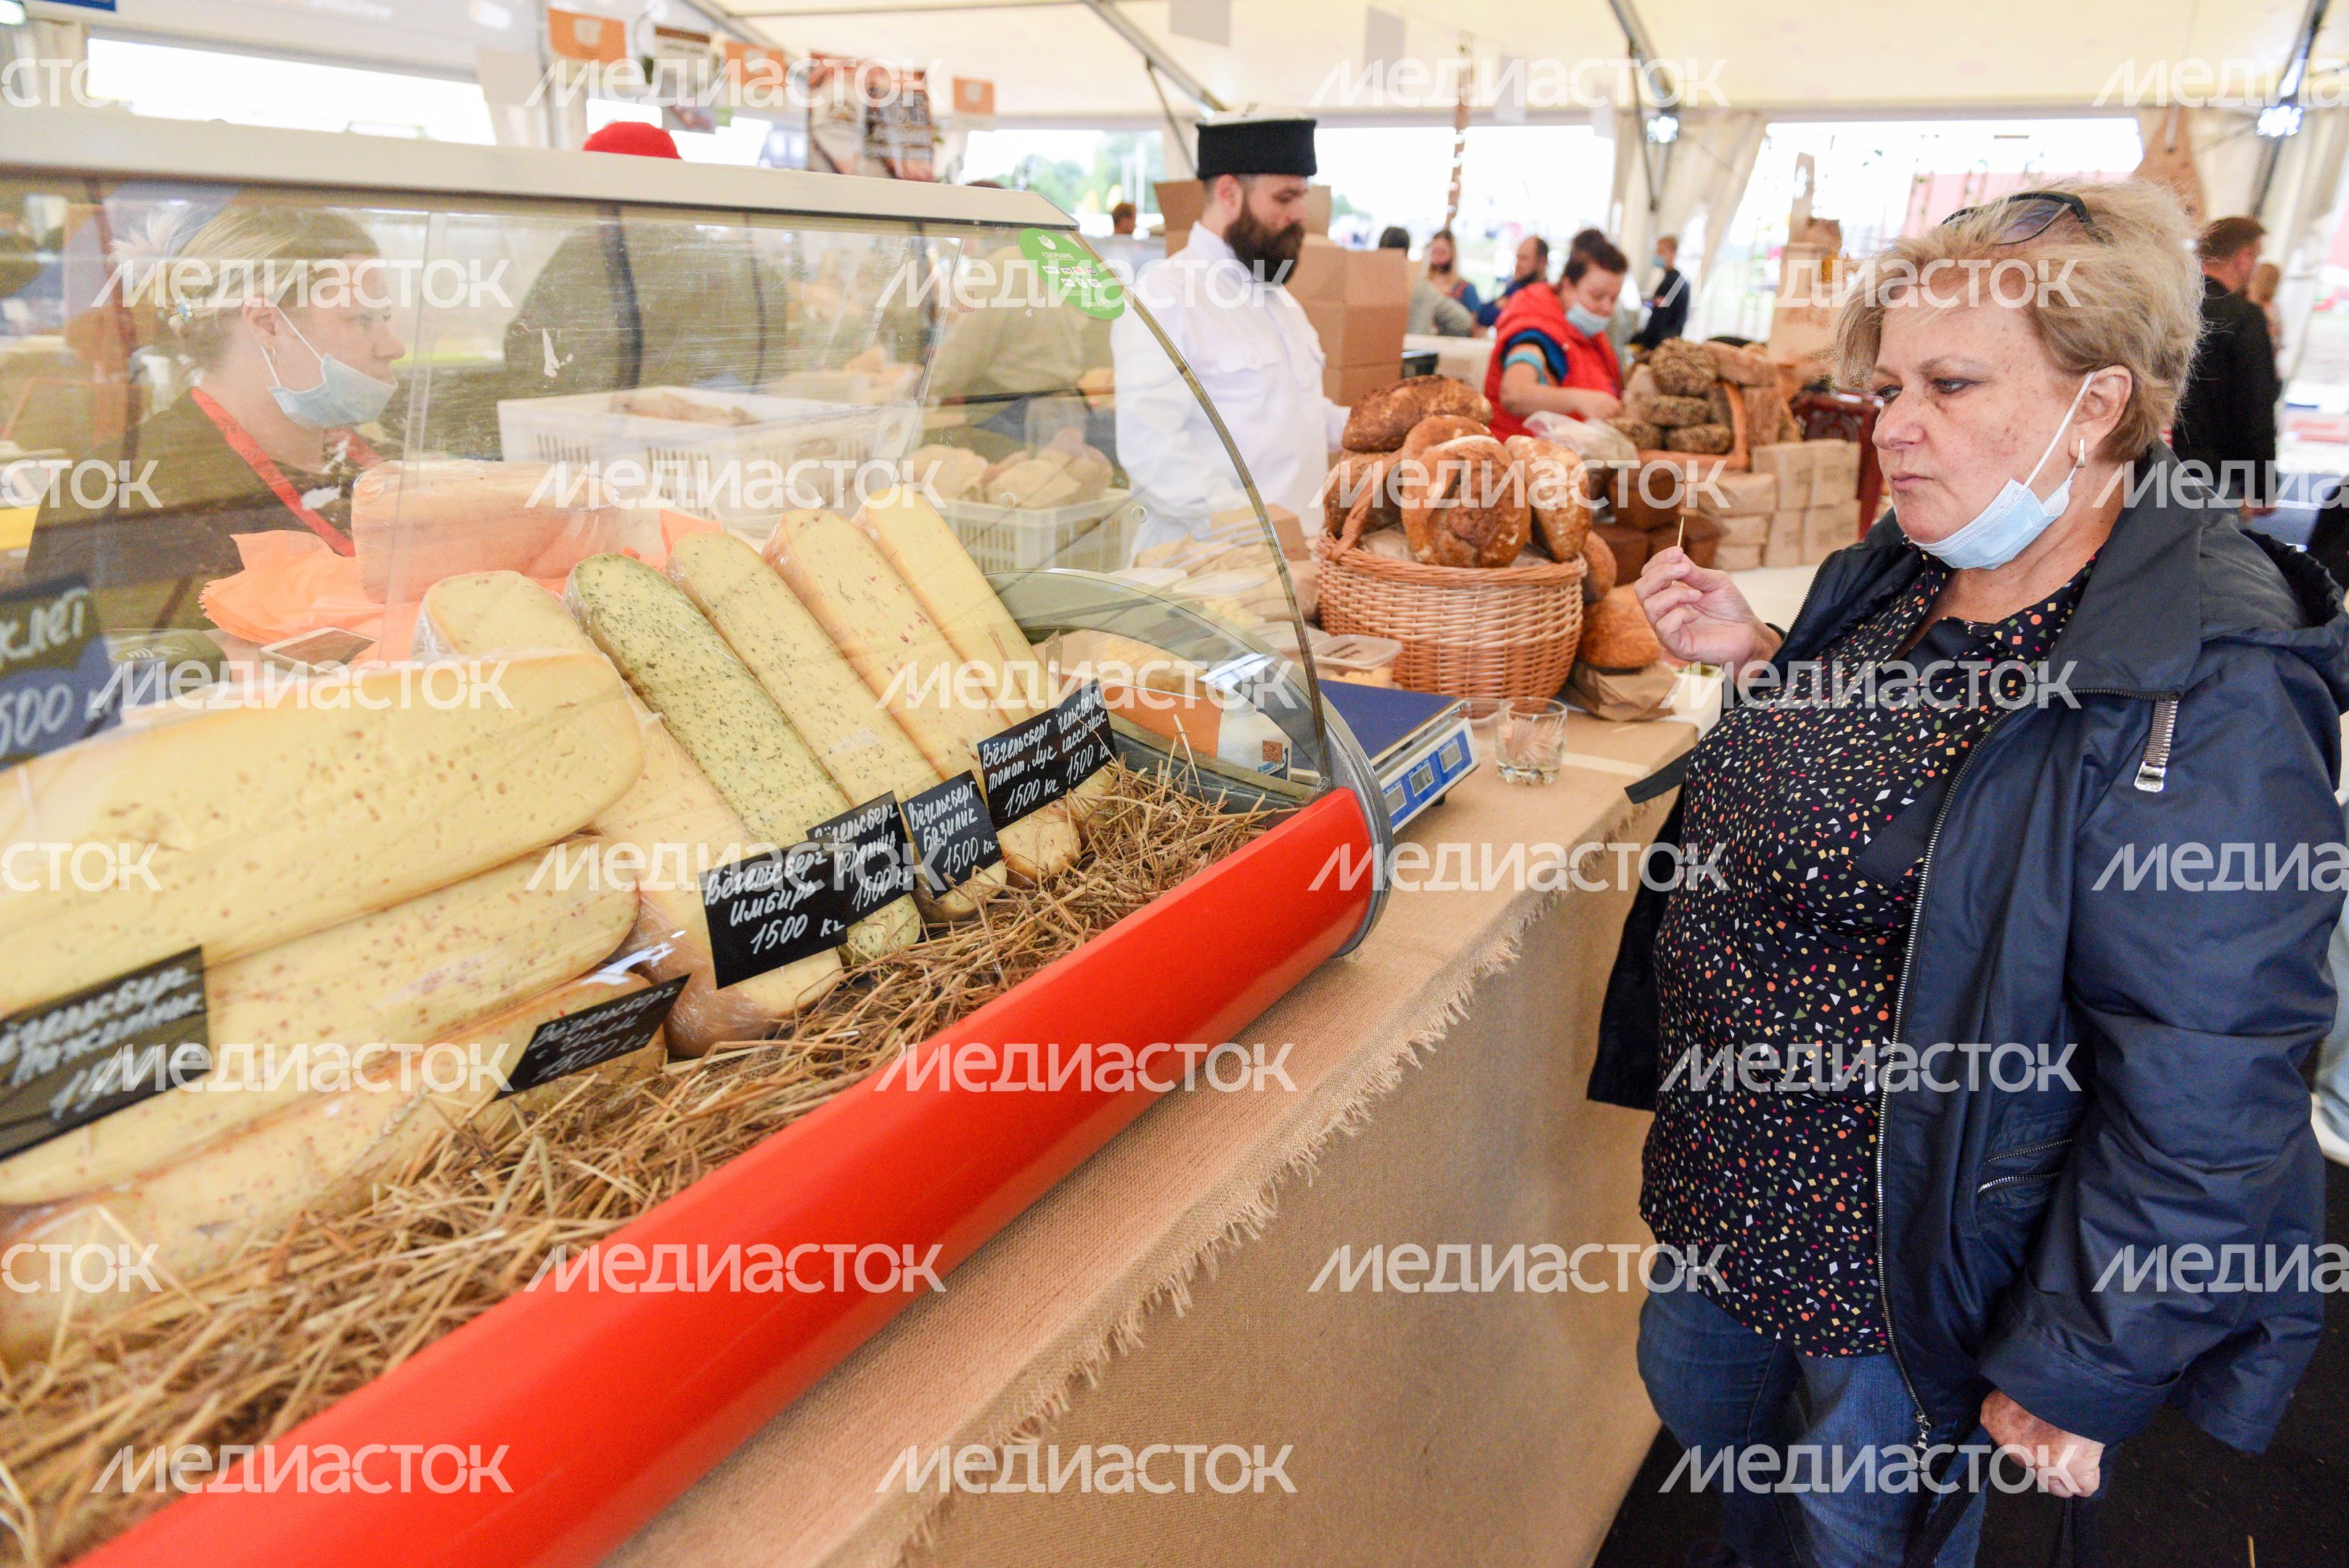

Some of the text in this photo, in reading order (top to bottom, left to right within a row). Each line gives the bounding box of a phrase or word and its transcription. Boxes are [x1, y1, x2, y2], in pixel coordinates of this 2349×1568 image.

[1066, 744, 1094, 785] 1500
[1005, 778, 1060, 818] 1500 кг
[943, 836, 996, 875] 1500 кг
[704, 851, 828, 906] Вёгельсберг
[851, 867, 891, 912] 1500
[750, 913, 846, 955] 1500 кг
